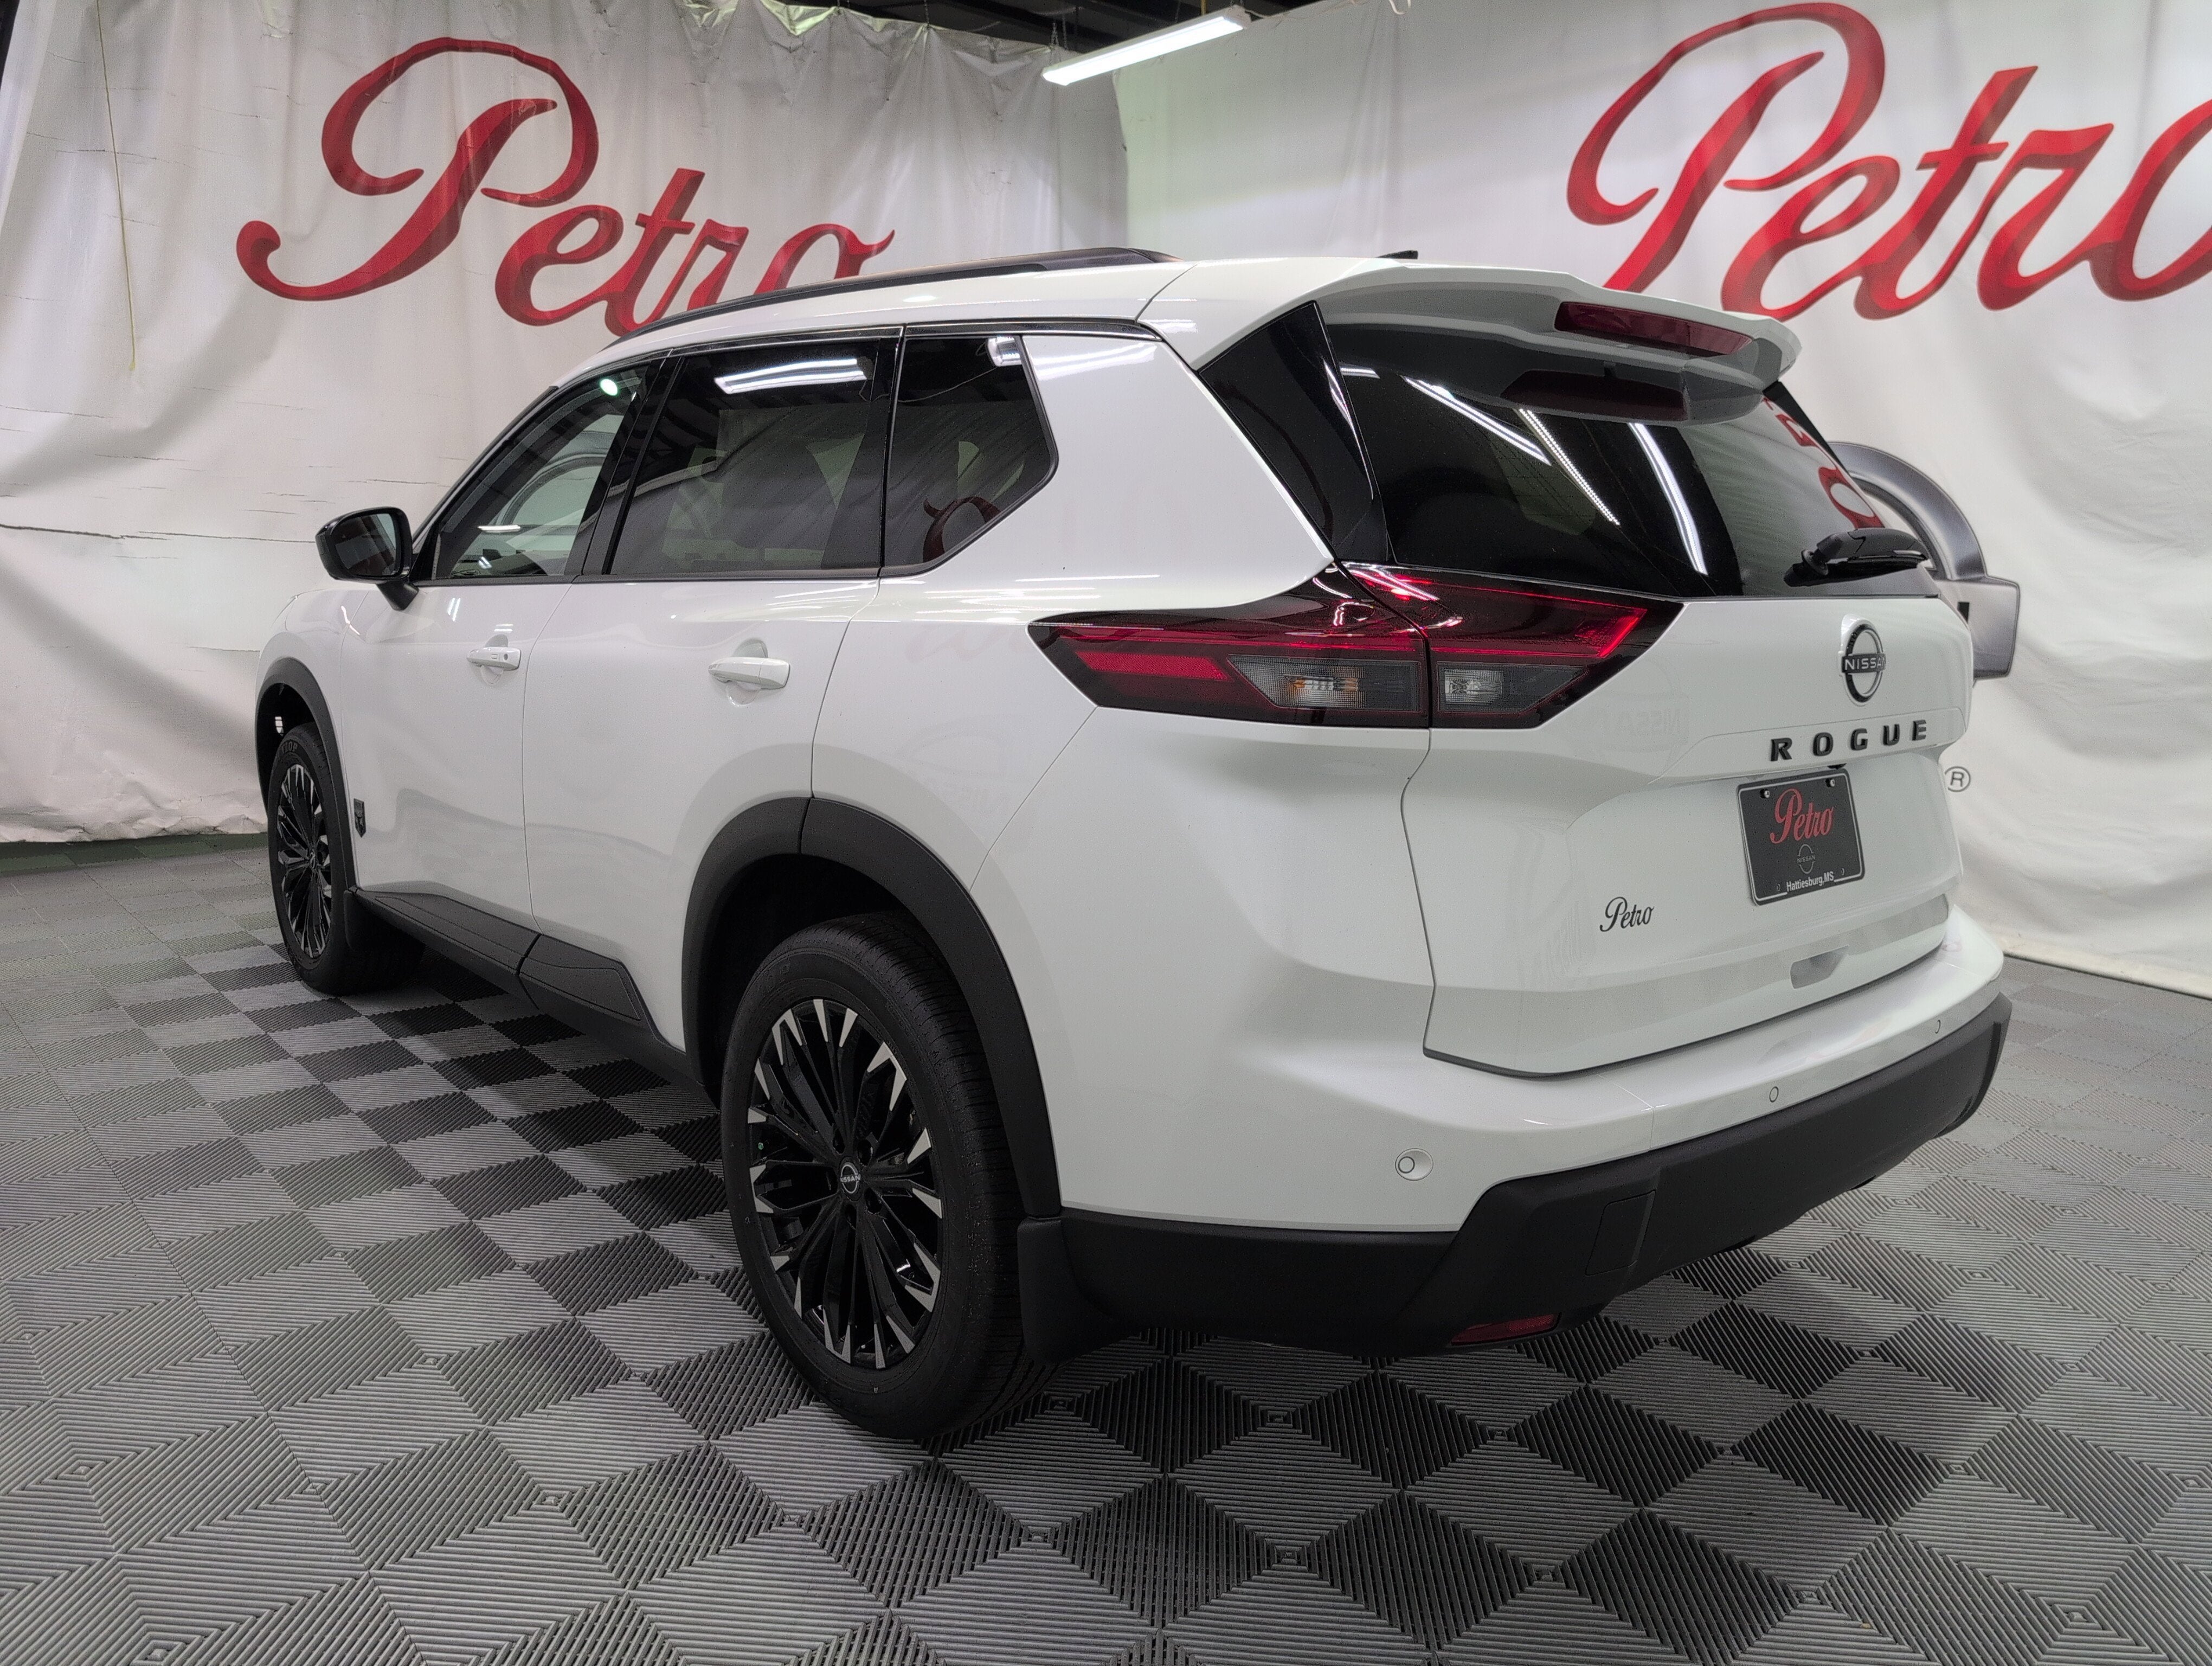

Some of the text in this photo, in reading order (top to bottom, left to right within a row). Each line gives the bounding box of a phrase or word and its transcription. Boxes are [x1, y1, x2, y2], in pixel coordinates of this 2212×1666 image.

[1770, 719, 1927, 761] ROGUE
[1770, 788, 1835, 844] Petro
[1797, 854, 1816, 863] NISSAN
[1599, 896, 1655, 932] Petro
